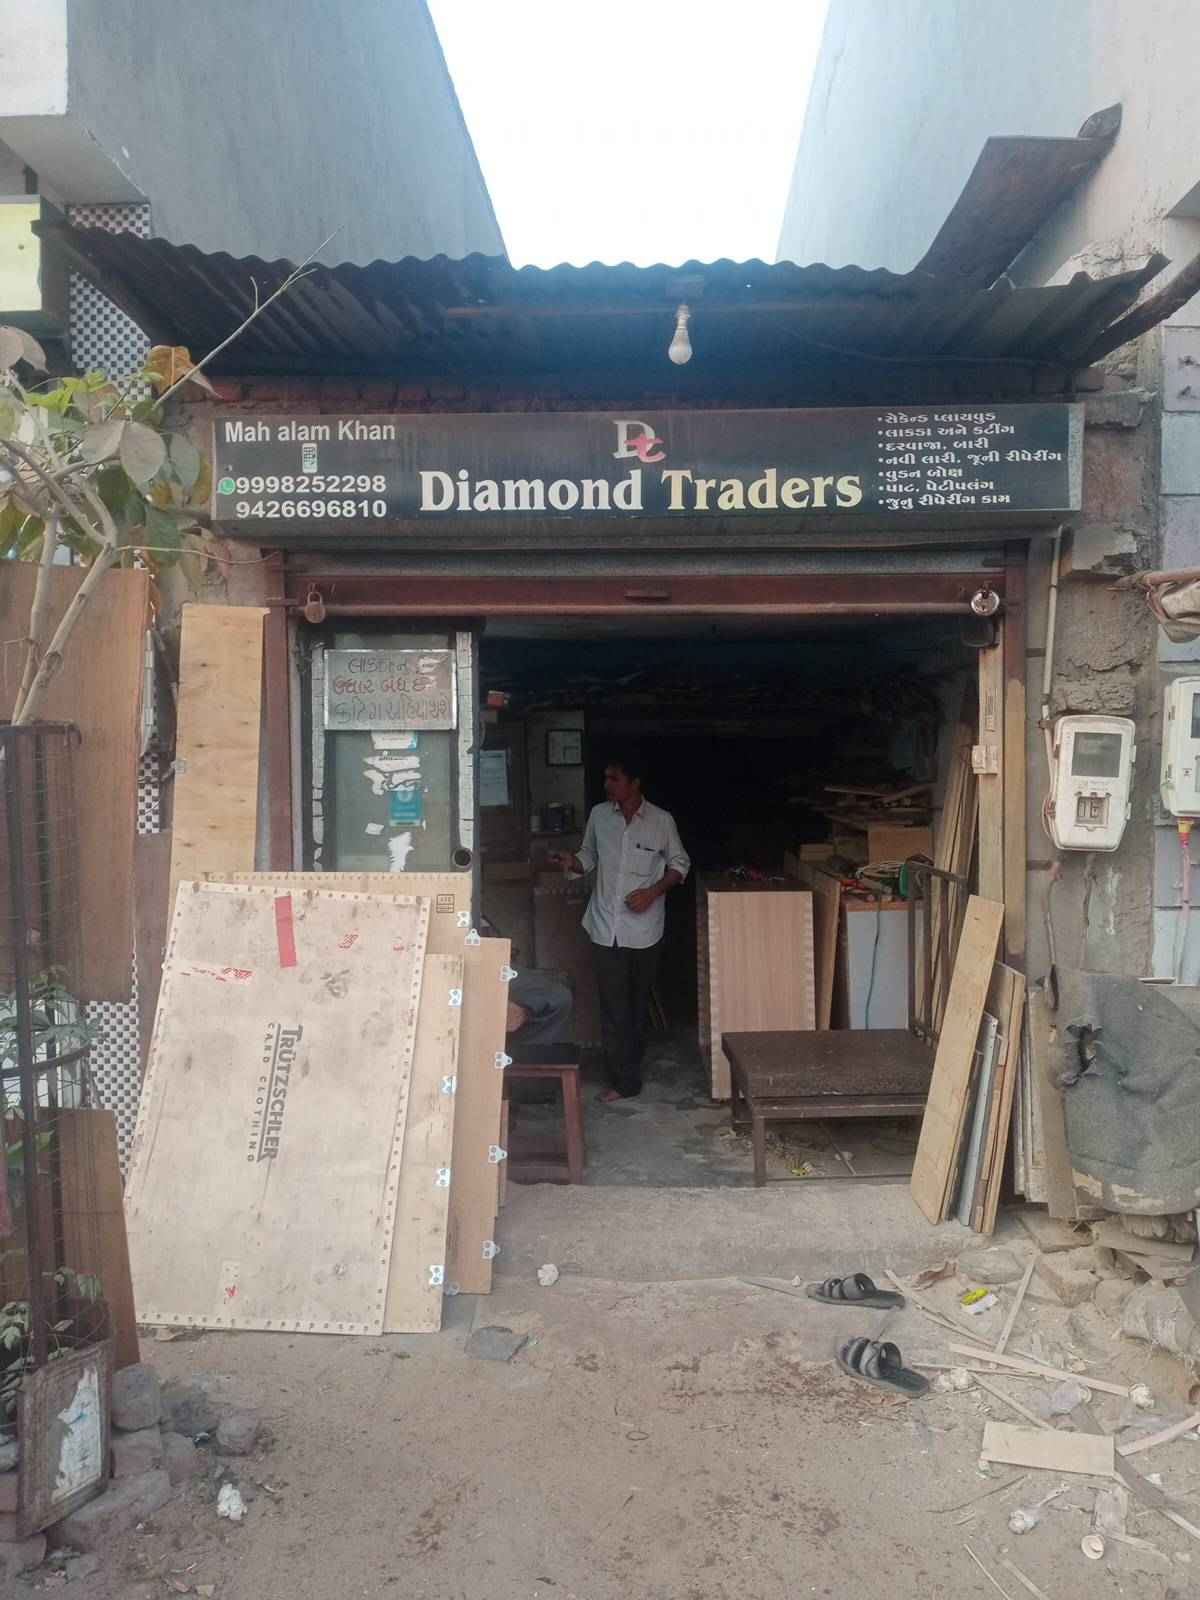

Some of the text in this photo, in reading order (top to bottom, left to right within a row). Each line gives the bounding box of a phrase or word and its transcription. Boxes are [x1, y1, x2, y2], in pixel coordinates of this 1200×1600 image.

[225, 420, 396, 442] Mah alam Khan
[937, 424, 967, 435] અને
[953, 437, 989, 449] બારી
[235, 475, 387, 494] 9998252298
[419, 468, 863, 511] Diamond Traders
[235, 499, 387, 518] 9426696810
